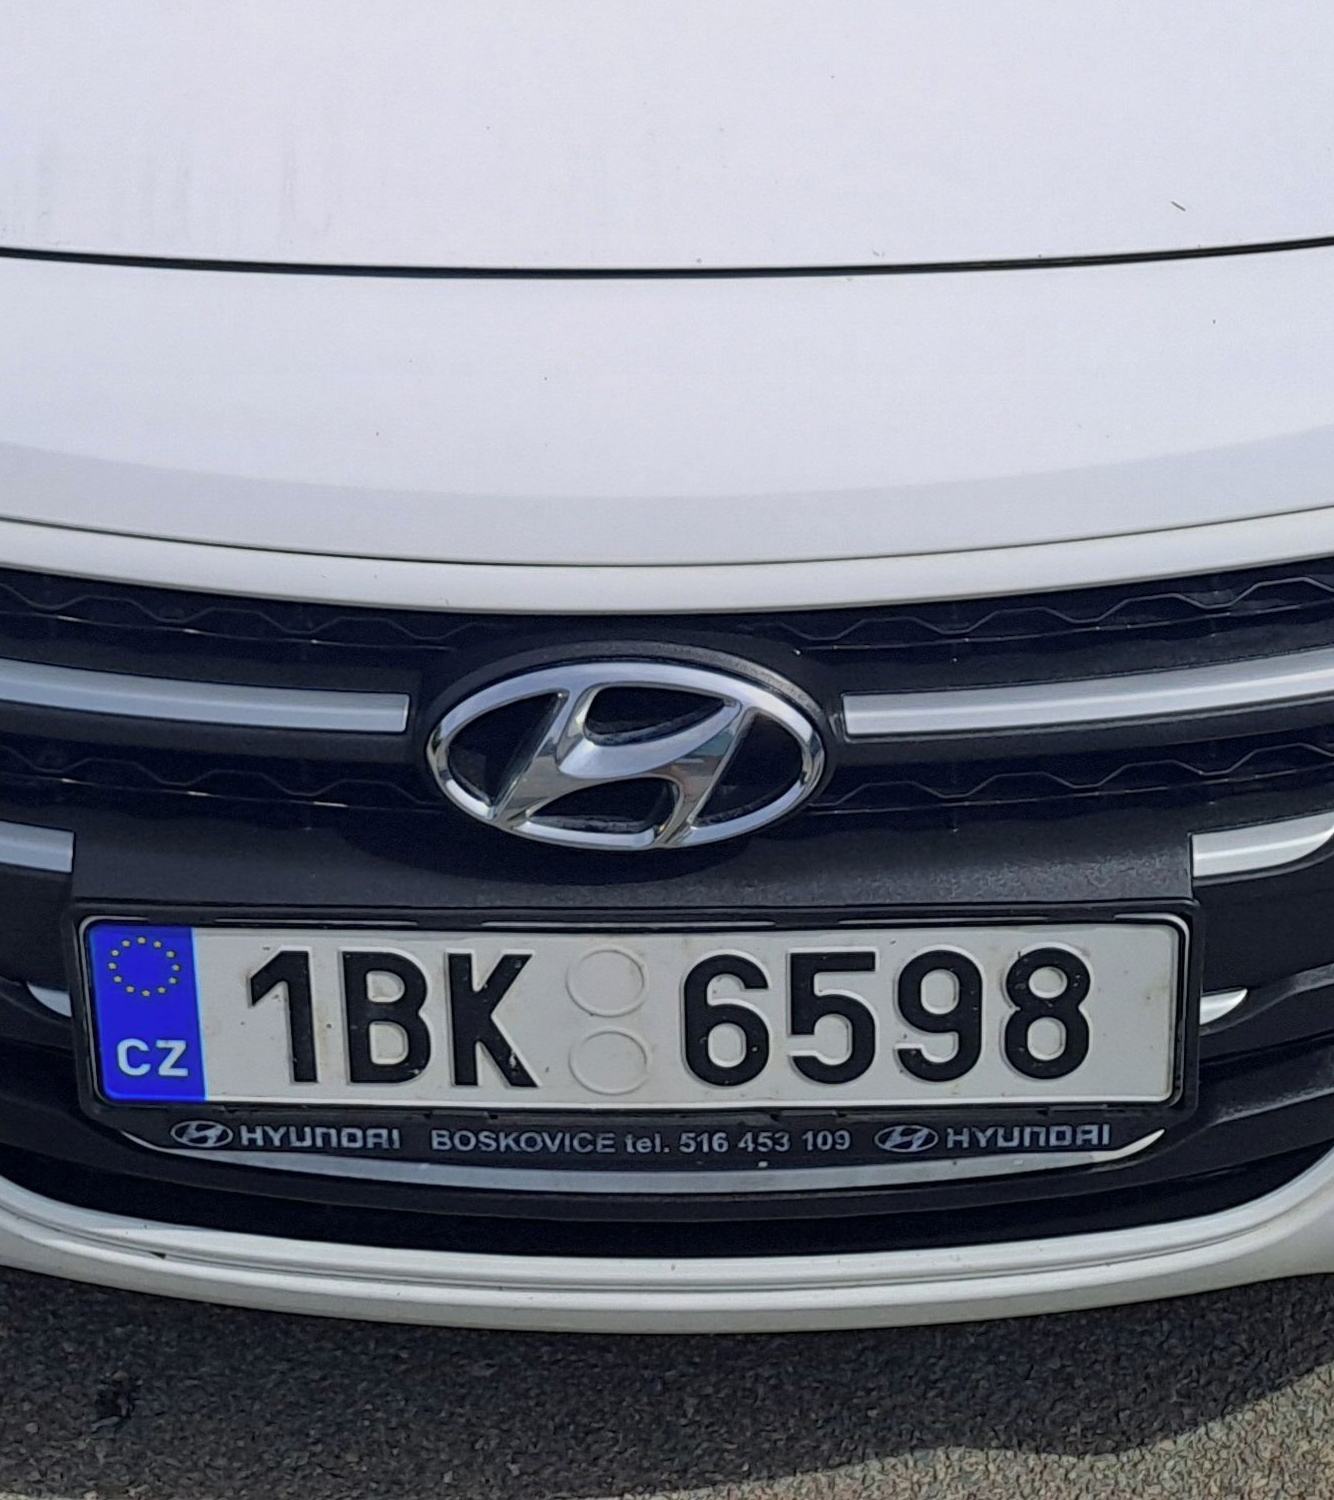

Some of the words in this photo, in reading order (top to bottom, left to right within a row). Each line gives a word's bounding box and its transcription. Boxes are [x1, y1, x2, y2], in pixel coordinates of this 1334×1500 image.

[249, 949, 540, 1089] 1BK
[683, 946, 1091, 1087] 6598
[116, 1038, 189, 1077] CZ
[240, 1124, 401, 1149] HYUNDAI
[431, 1129, 616, 1153] BOSKOVICE
[625, 1132, 670, 1153] tel.
[679, 1132, 729, 1153] 516
[738, 1131, 791, 1152] 453
[802, 1129, 851, 1151] 109
[946, 1124, 1111, 1149] HYUNDAI
